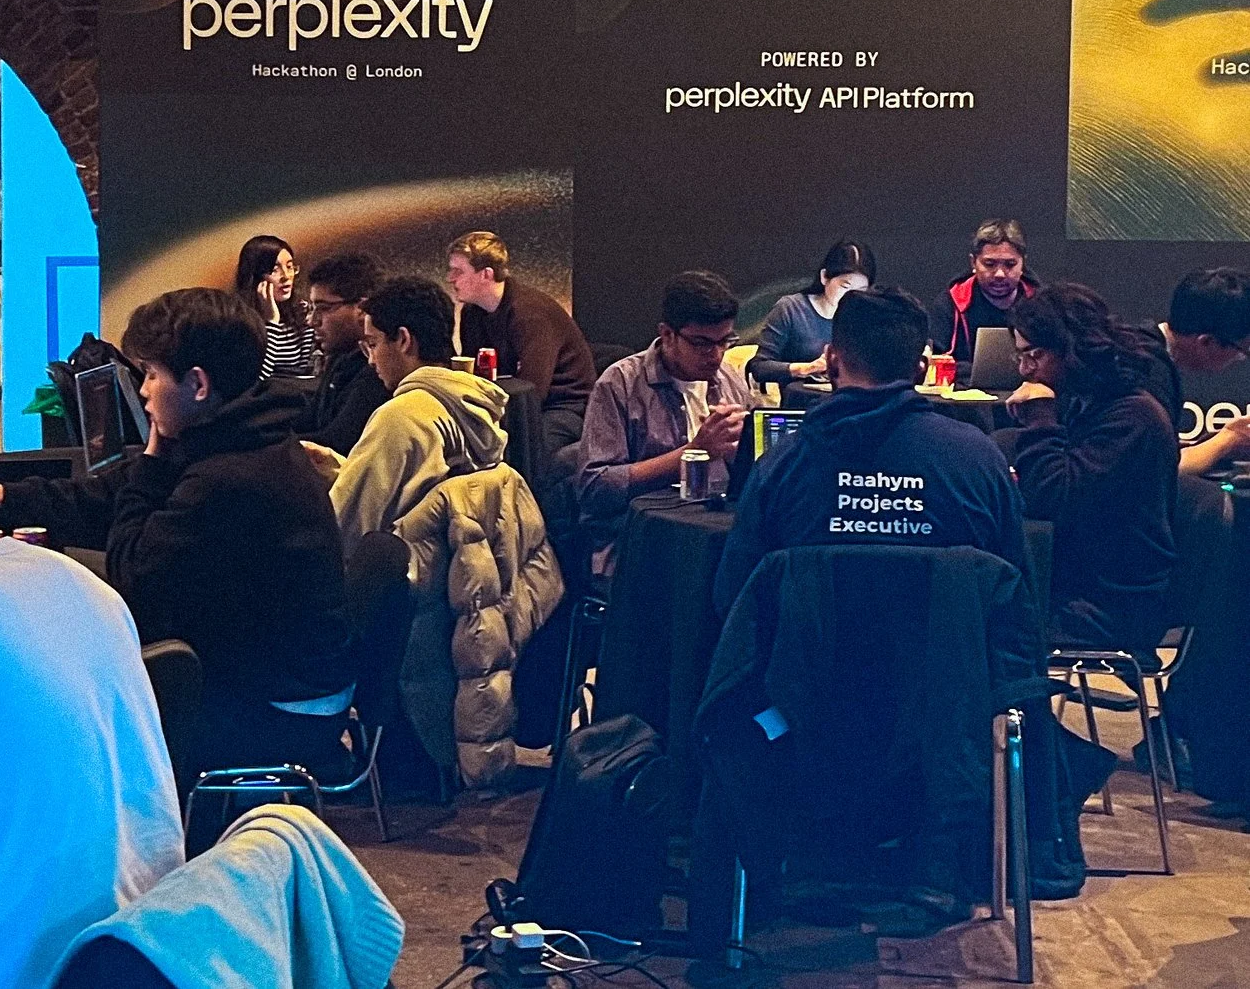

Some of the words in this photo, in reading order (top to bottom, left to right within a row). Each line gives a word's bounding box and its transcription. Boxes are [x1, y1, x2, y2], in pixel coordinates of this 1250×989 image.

[760, 51, 843, 68] POWERED
[855, 51, 879, 68] BY
[252, 64, 338, 78] Hackathon
[346, 64, 357, 81] @
[365, 64, 423, 78] London
[665, 81, 812, 114] perplexity
[818, 86, 860, 109] API
[863, 86, 975, 109] Platform
[837, 471, 924, 492] Raahym
[837, 493, 924, 514] Projects
[829, 516, 933, 535] Executive
